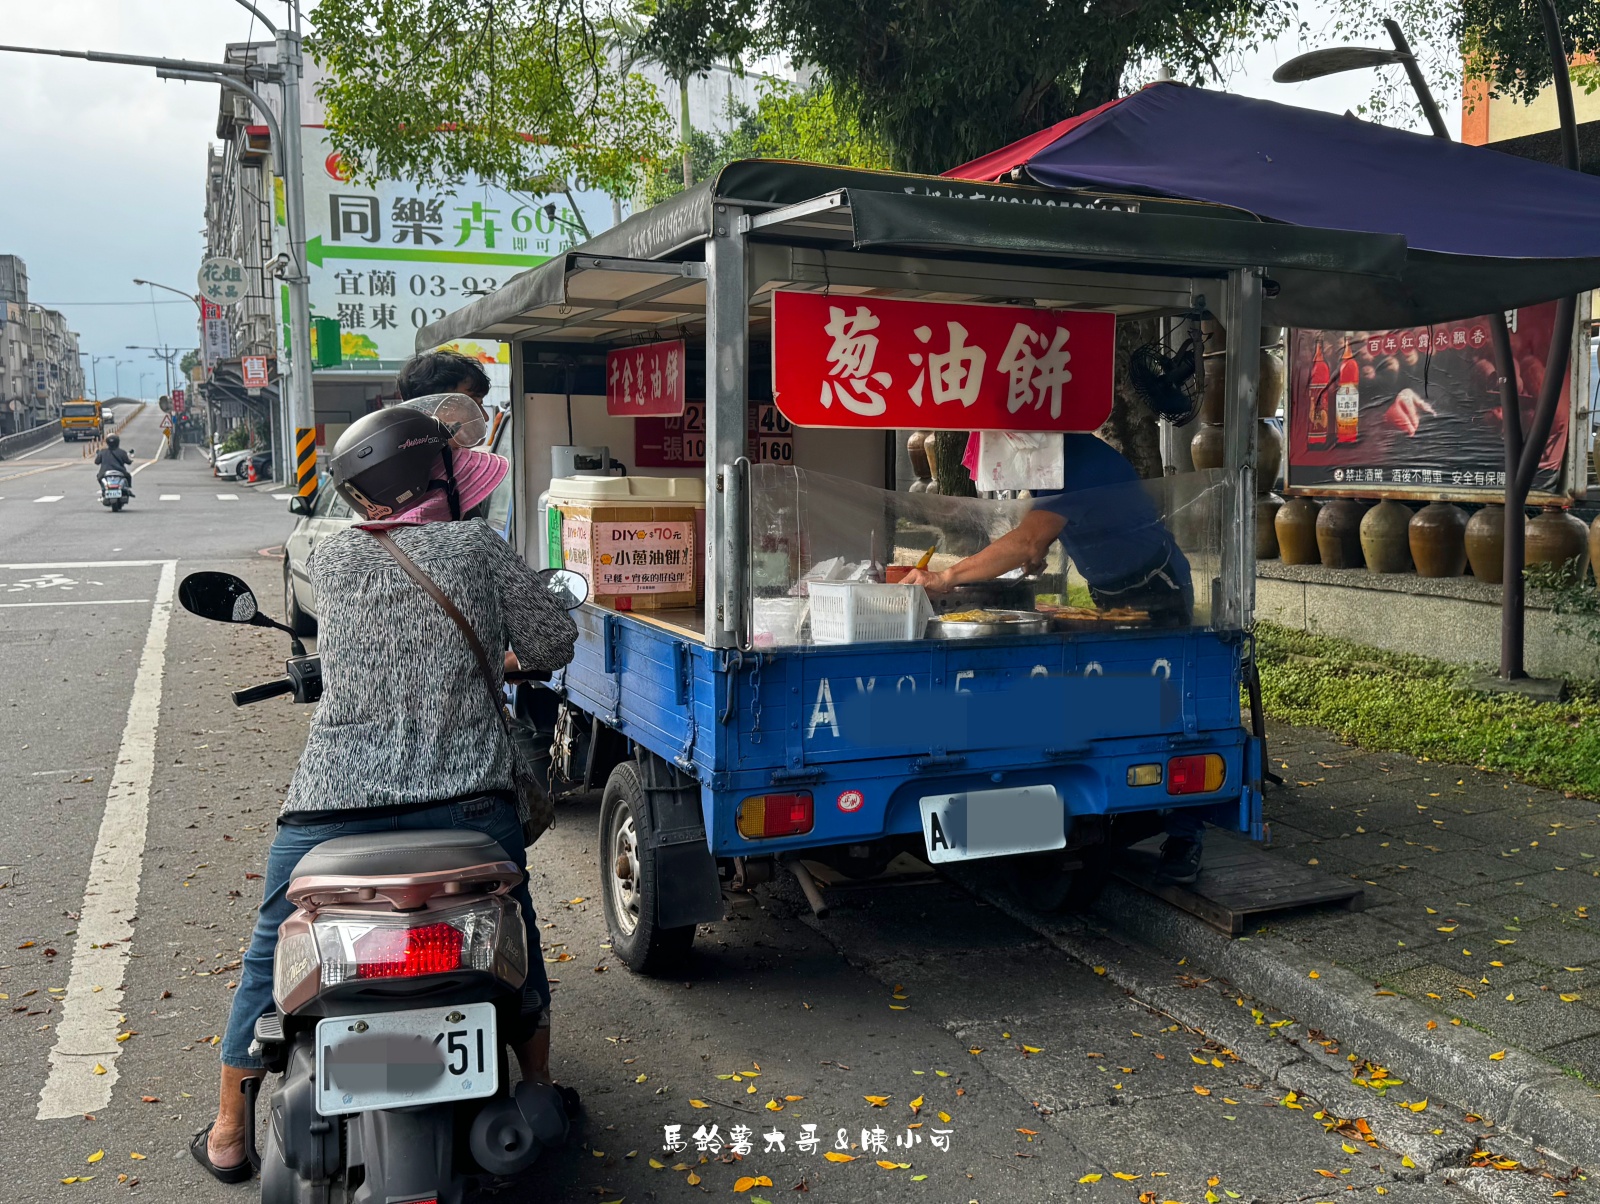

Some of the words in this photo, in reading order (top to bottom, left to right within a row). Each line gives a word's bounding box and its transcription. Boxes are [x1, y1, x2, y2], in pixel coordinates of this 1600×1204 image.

[329, 193, 503, 249] 同樂卉
[203, 263, 243, 283] 花姐
[334, 268, 397, 298] 宜蘭
[336, 302, 399, 331] 羅東
[1368, 329, 1485, 352] 百年紅露永飄香
[244, 358, 265, 379] 售
[685, 405, 706, 430] 2
[760, 406, 790, 433] 40
[642, 436, 682, 461] 一張
[760, 441, 792, 461] 160
[1345, 468, 1383, 482] 禁止酒駕
[1391, 469, 1442, 483] 酒後不開車
[1451, 470, 1506, 486] 安全有保障
[612, 529, 637, 541] DIY
